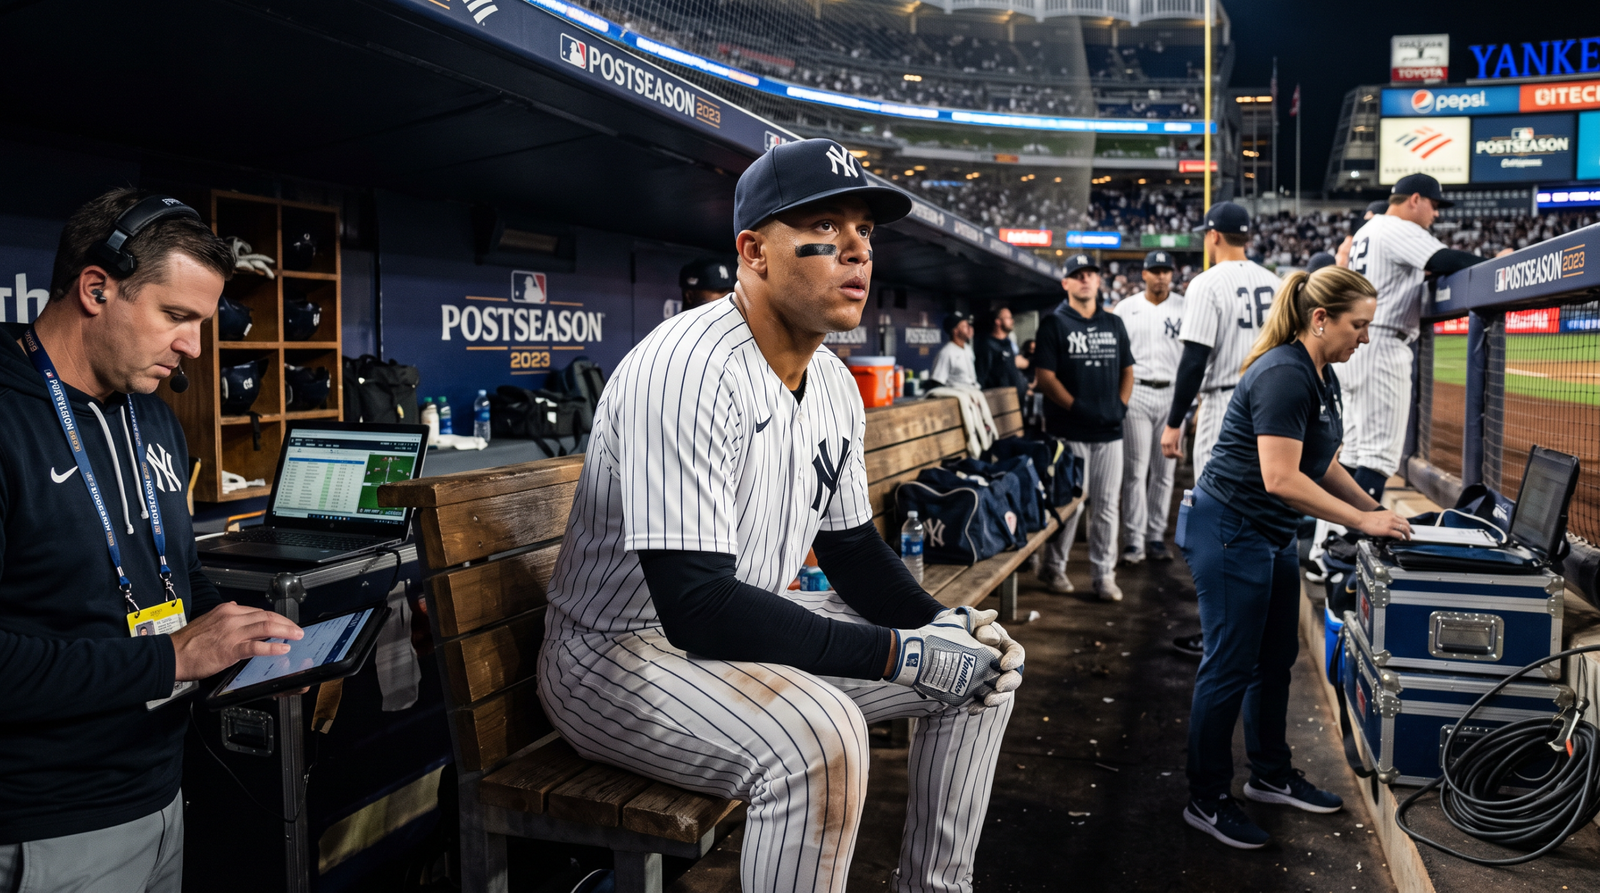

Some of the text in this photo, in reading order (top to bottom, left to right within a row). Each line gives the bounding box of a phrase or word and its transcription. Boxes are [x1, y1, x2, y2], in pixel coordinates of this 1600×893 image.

[589, 46, 695, 118] POSTSEASON
[696, 102, 721, 124] 2023
[1399, 68, 1444, 79] TOYOTA
[1436, 90, 1486, 111] pepsi
[1475, 137, 1569, 154] POSTSEASON
[826, 145, 859, 178] NY
[1505, 250, 1586, 291] POSTSEASON 2023
[441, 304, 602, 342] POSTSEASON
[1164, 317, 1182, 338] NY
[1067, 331, 1089, 354] NY
[510, 352, 551, 368] 2023
[145, 443, 182, 492] NY
